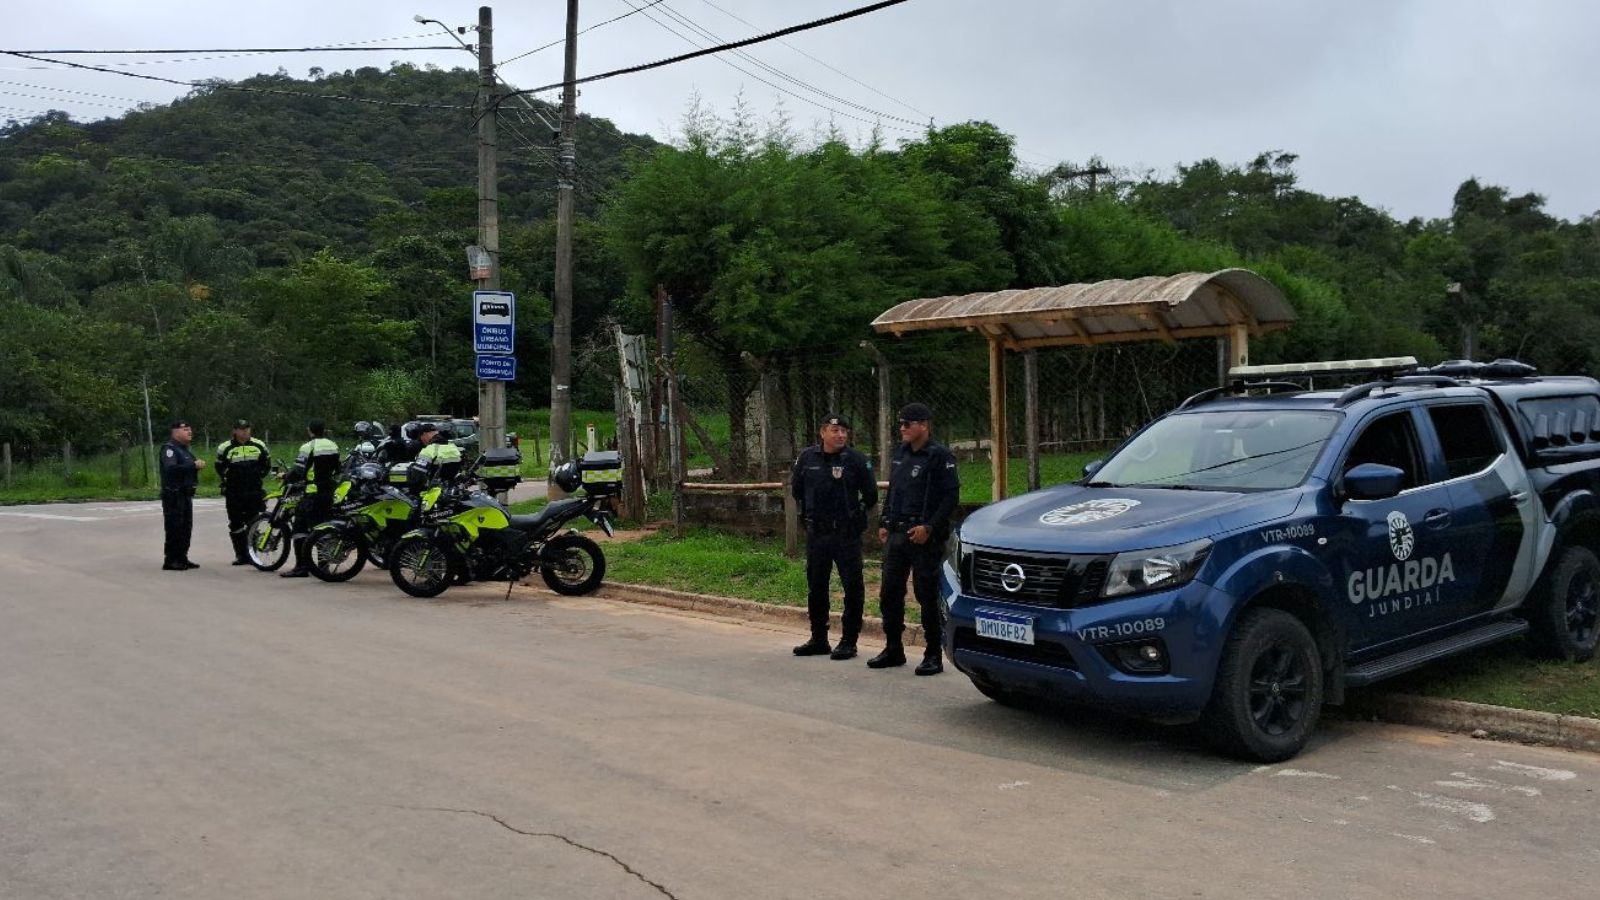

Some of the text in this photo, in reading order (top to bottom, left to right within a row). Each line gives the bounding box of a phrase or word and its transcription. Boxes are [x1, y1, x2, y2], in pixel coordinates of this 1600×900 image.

[1261, 524, 1315, 543] VTR-10089
[1348, 552, 1456, 604] GUARDA
[1369, 585, 1440, 618] JUNDIAÍ
[1077, 617, 1165, 641] VTR-10089
